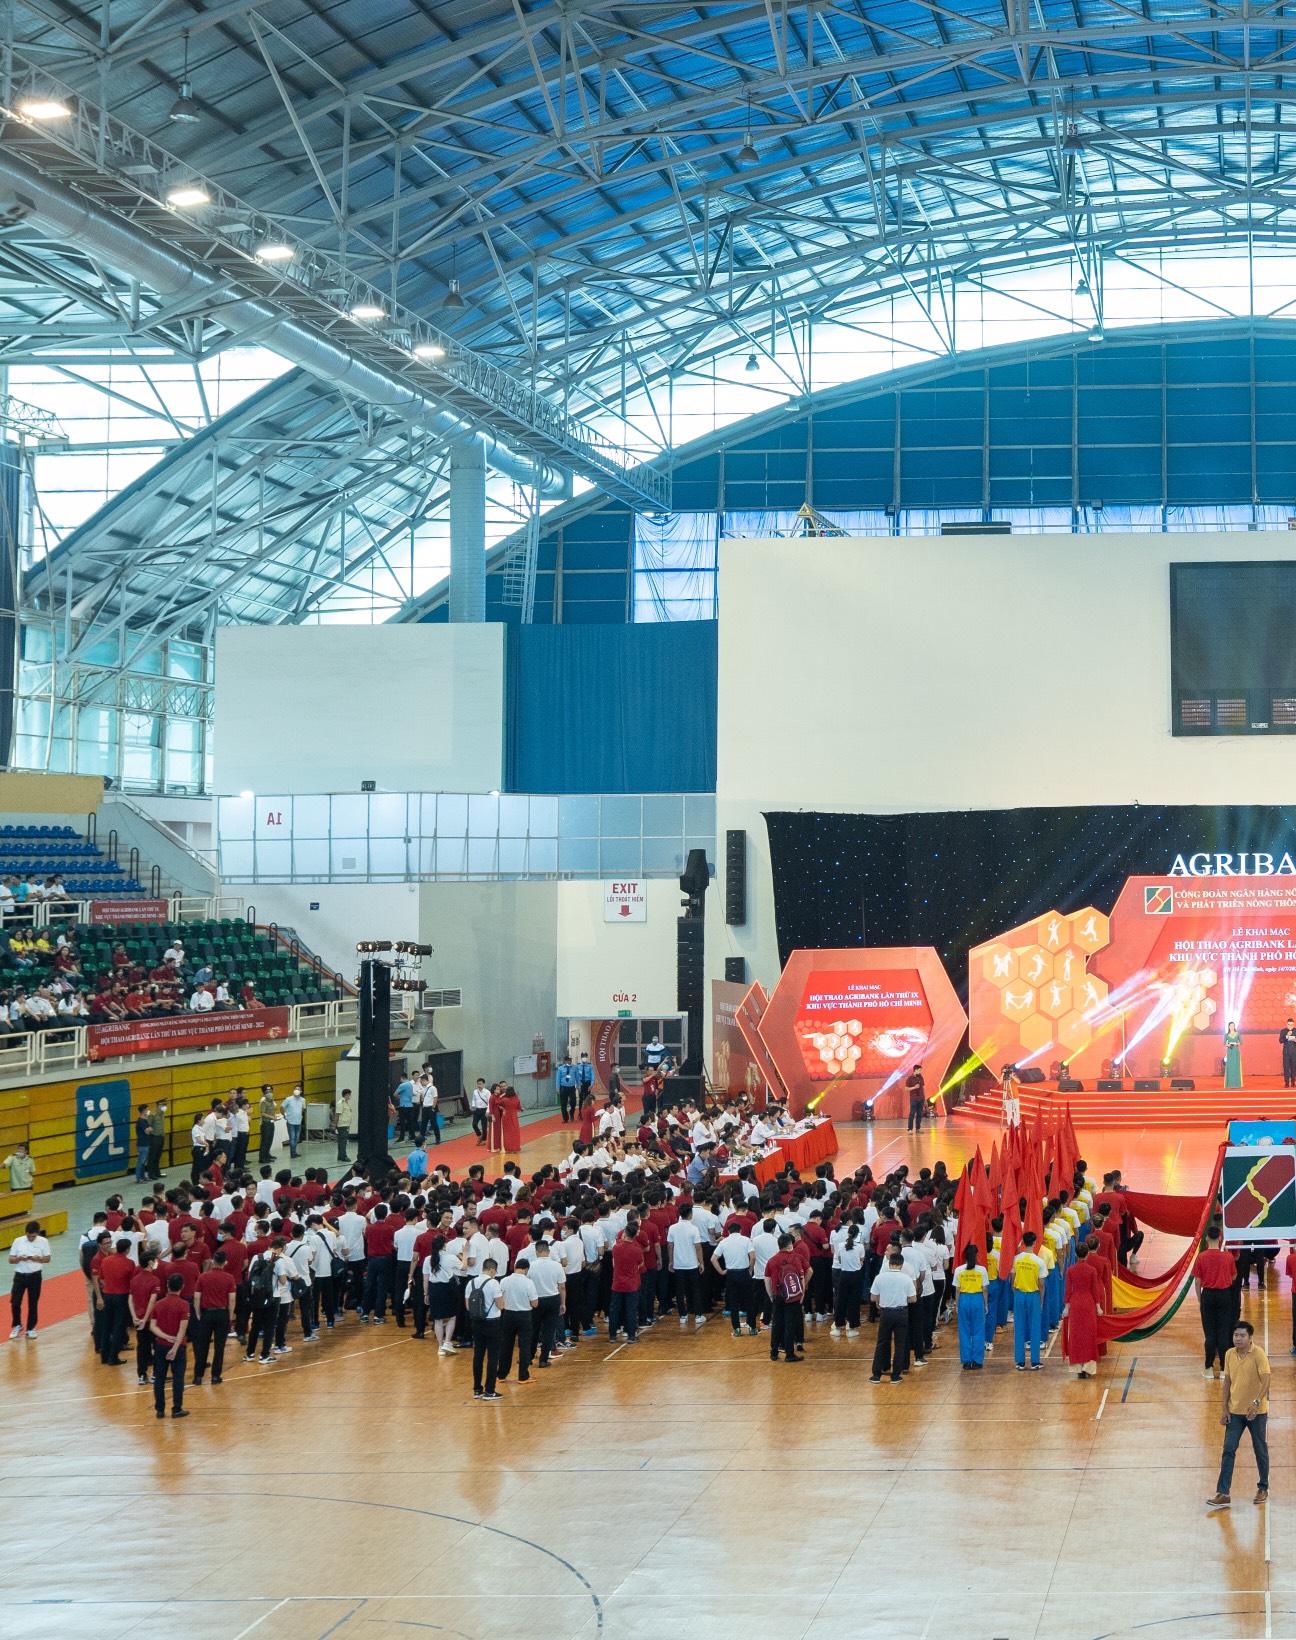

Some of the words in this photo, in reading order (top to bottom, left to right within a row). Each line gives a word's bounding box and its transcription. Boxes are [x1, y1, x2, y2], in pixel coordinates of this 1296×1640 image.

[612, 883, 638, 893] EXIT
[1175, 889, 1200, 898] CÔNG
[1202, 888, 1228, 898] ĐOÀN
[1230, 888, 1256, 897] NGÂN
[1258, 888, 1282, 897] HÀNG
[632, 894, 644, 902] HIỂM
[1177, 899, 1189, 908] VÀ
[1191, 899, 1215, 908] PHÁT
[1246, 898, 1272, 907] NÔNG
[1245, 928, 1268, 936] KHAI
[1270, 928, 1290, 937] MẠC
[1175, 940, 1194, 951] HỘI
[1197, 940, 1227, 950] THAO
[1229, 940, 1286, 949] AGRIBANK
[1169, 953, 1192, 962] KHU
[1195, 952, 1218, 963] VỰC
[1220, 950, 1258, 961] THÀNH
[613, 990, 629, 1002] CỬA
[632, 994, 637, 1002] 2
[601, 1025, 612, 1045] THAO
[599, 1048, 607, 1062] HỘI
